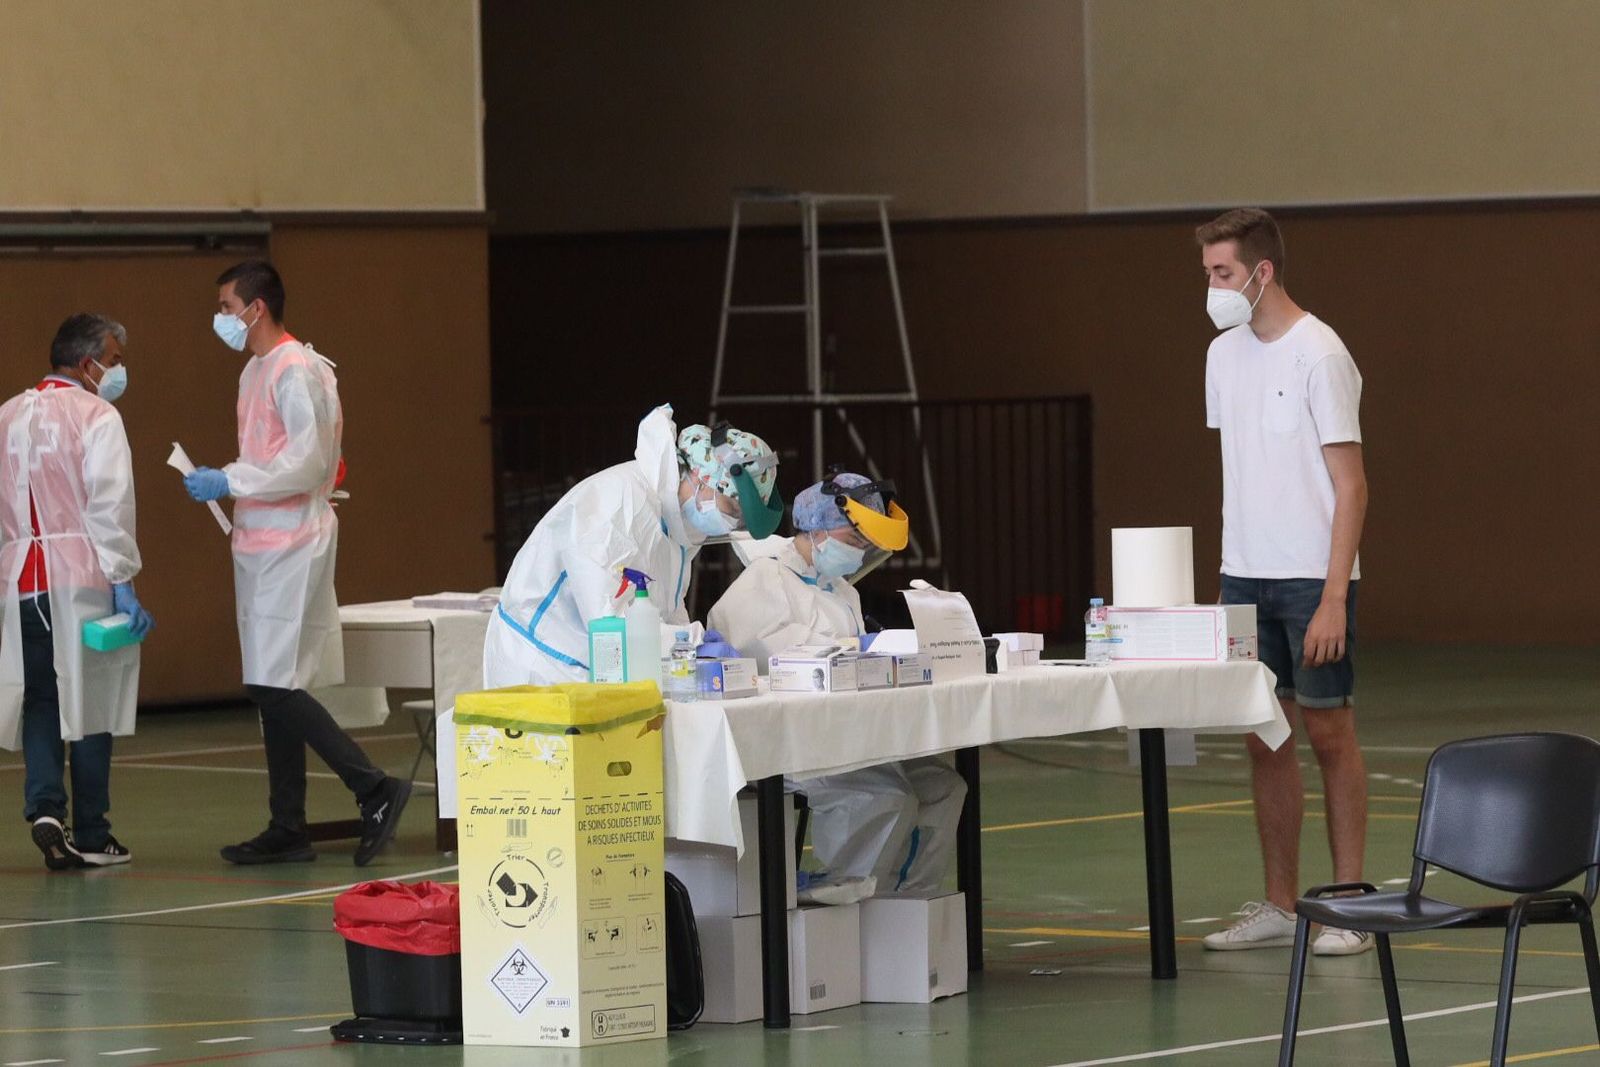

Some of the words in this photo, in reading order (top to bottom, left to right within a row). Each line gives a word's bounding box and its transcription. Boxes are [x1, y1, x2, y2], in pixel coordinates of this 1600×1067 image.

[751, 675, 758, 688] S
[923, 668, 932, 681] M
[517, 805, 530, 815] 50
[531, 806, 537, 815] L
[540, 805, 561, 815] haut
[585, 803, 613, 815] DECHETS
[621, 800, 653, 812] ACTIVITES
[578, 820, 587, 831] DE
[587, 819, 607, 831] SOINS
[607, 817, 633, 829] SOLIDES
[633, 816, 641, 827] ET
[642, 815, 662, 826] MOUS
[587, 835, 592, 846] A
[592, 833, 619, 845] RISQUES
[620, 831, 655, 844] INFECTIEUX
